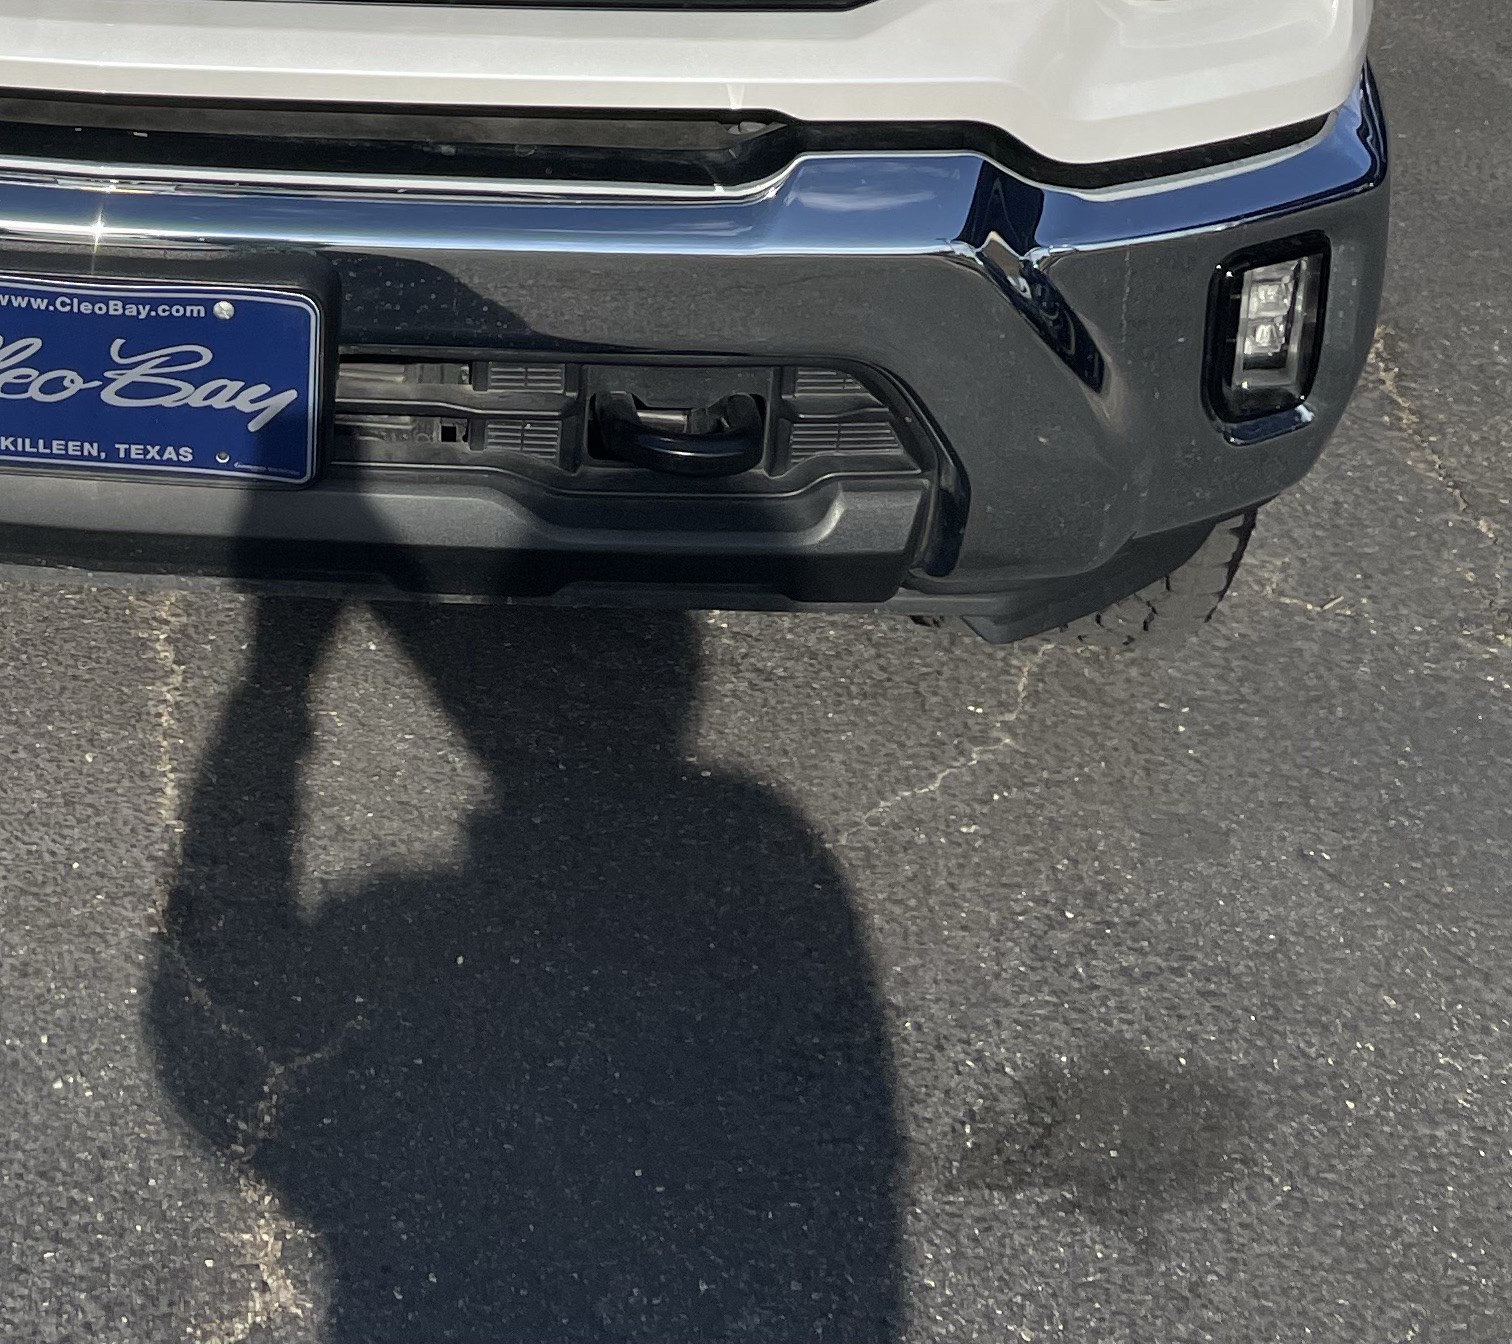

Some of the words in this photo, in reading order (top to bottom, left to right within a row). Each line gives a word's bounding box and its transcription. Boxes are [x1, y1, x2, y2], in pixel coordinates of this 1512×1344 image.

[100, 338, 299, 433] Bay
[0, 435, 107, 459] KILLEEN,
[115, 443, 194, 463] TEXAS
